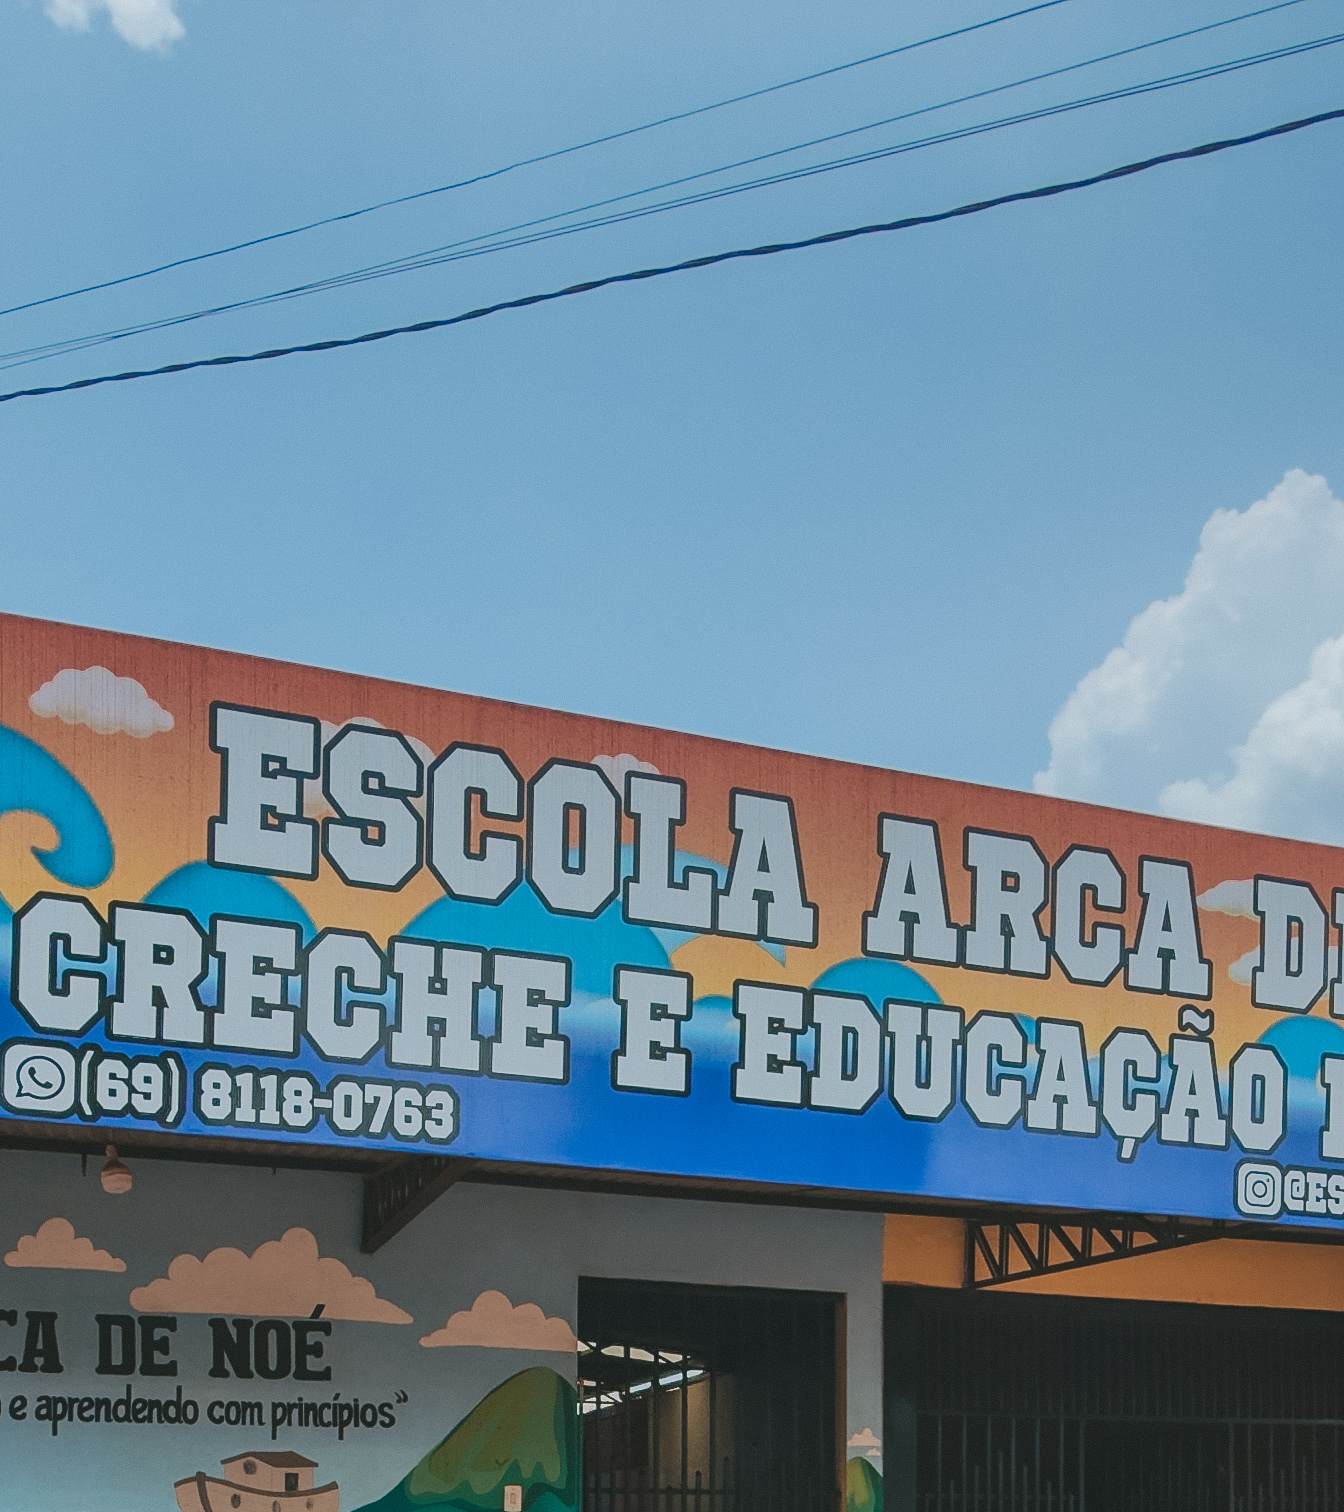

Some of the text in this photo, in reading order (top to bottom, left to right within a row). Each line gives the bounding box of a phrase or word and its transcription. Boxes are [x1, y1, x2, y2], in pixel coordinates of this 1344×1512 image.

[210, 703, 817, 947] ESCOLA
[864, 815, 1212, 999] ARCA
[13, 893, 570, 1082] CRECHE
[613, 966, 692, 1095] E
[733, 983, 1288, 1161] EDUCAÇÃO
[78, 1050, 456, 1142] (69) 8118-0763
[94, 1313, 179, 1377] DE
[207, 1303, 333, 1382] NOÉ
[8, 1395, 28, 1421] e
[34, 1384, 200, 1437] aprendendo
[207, 1399, 266, 1427] com
